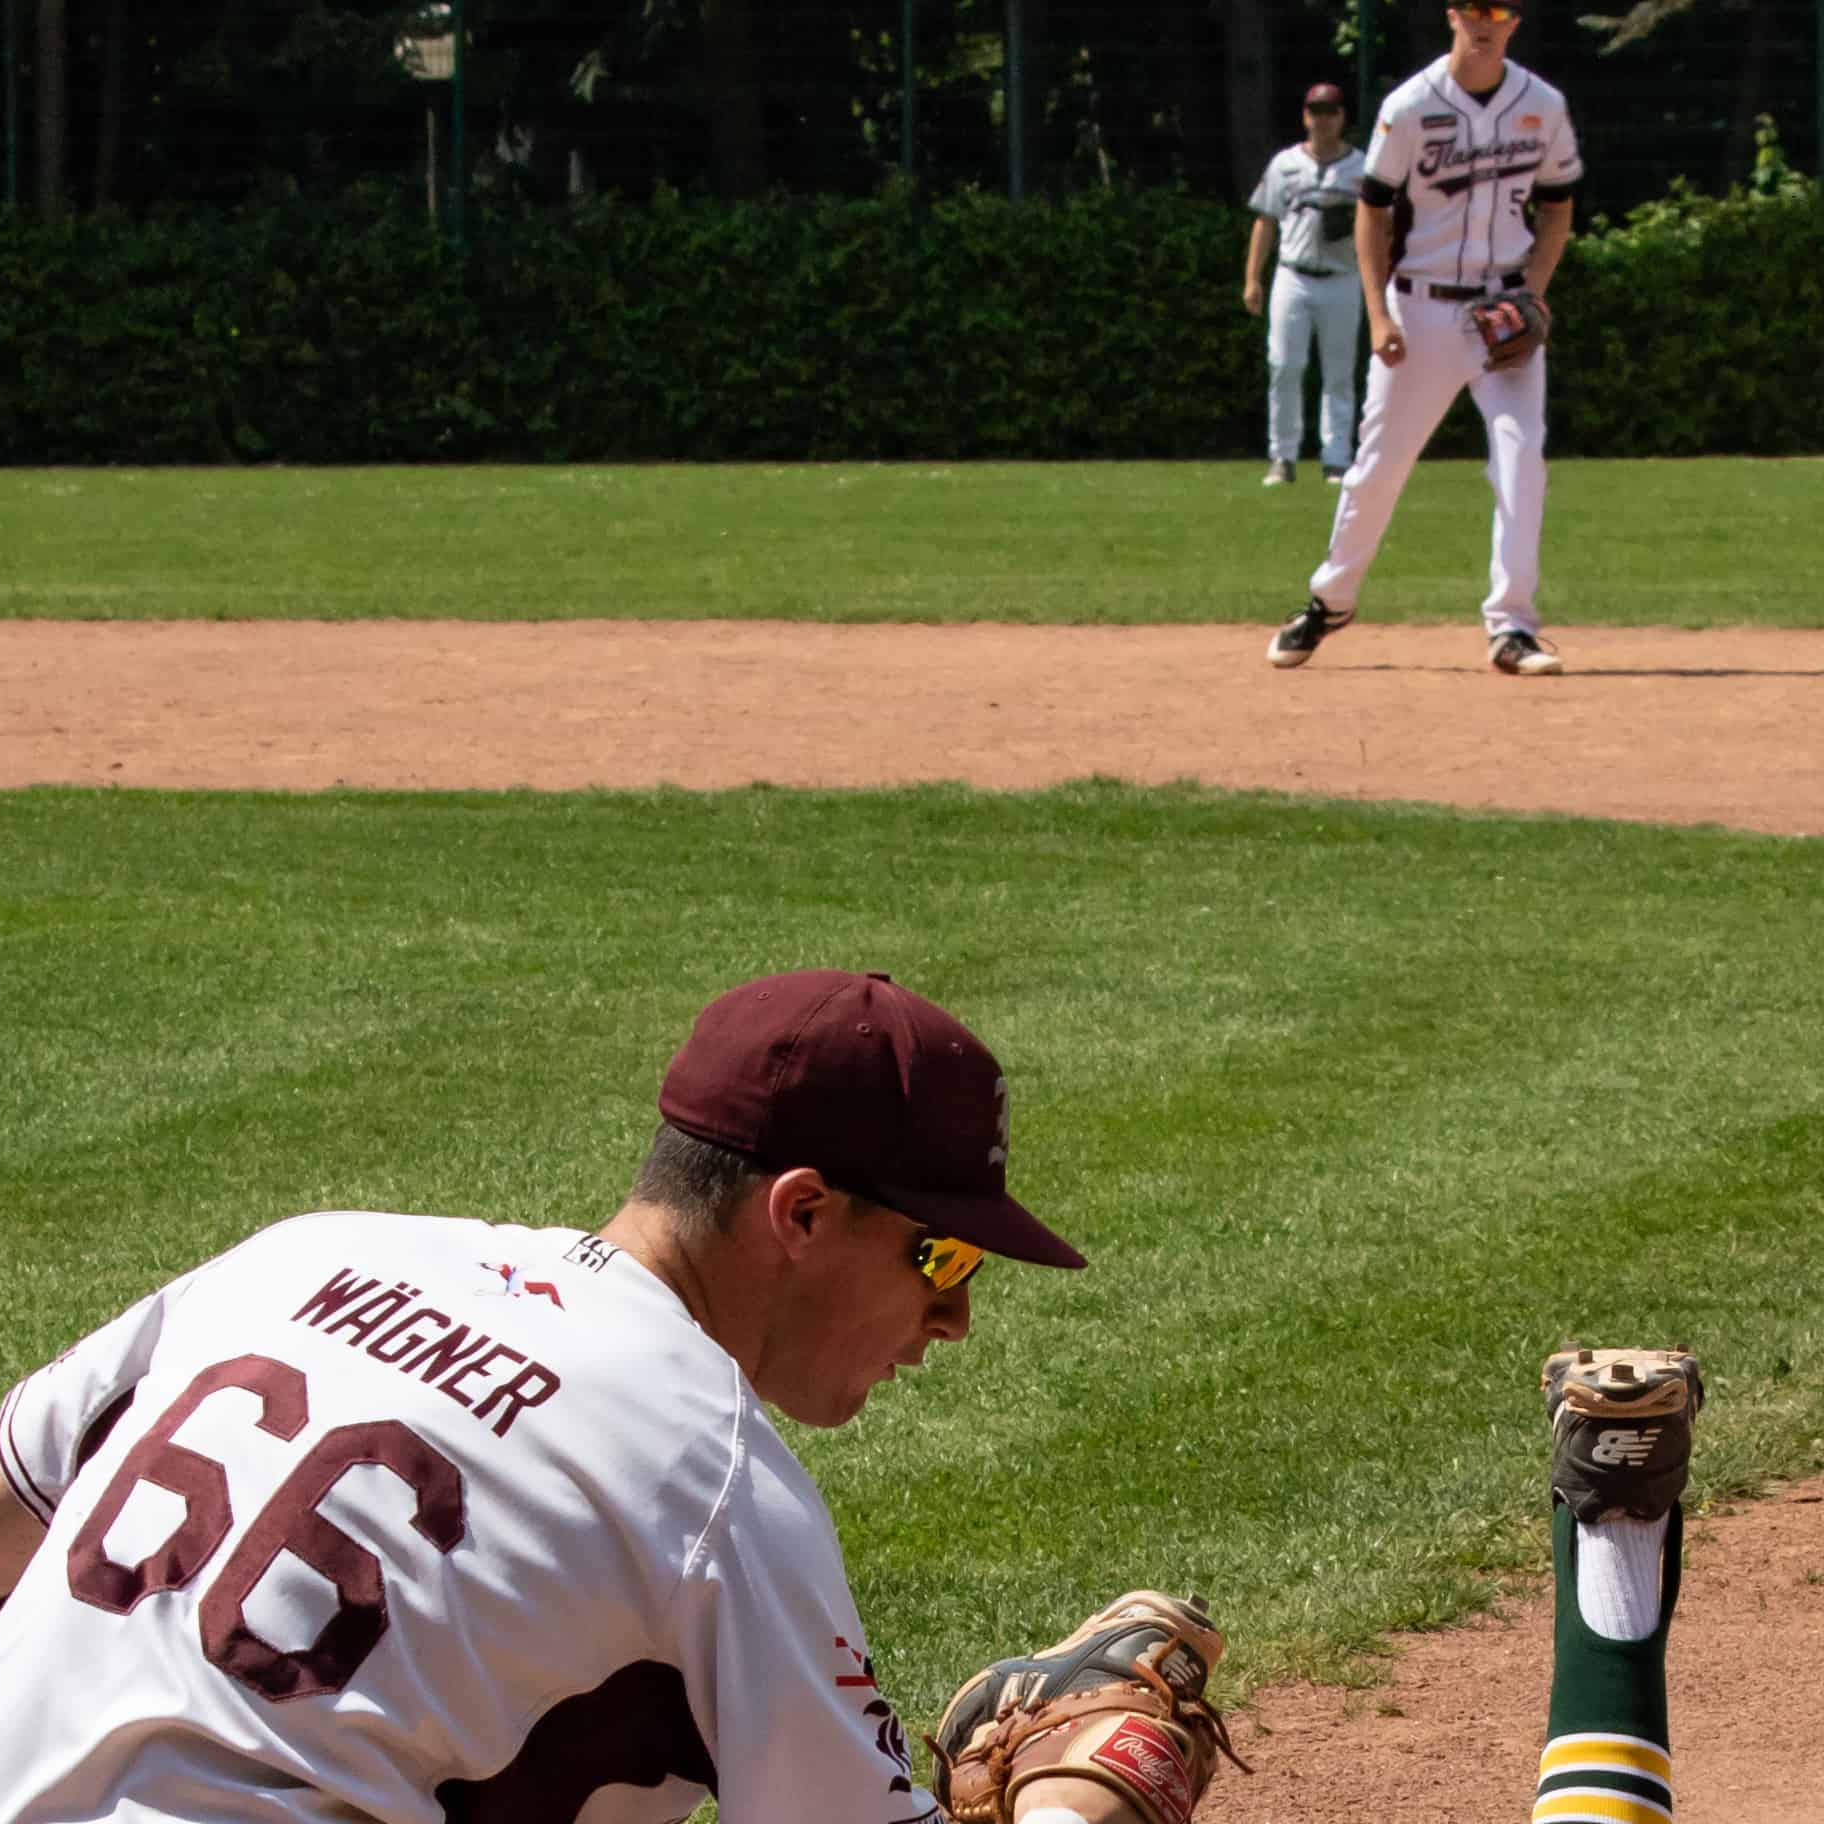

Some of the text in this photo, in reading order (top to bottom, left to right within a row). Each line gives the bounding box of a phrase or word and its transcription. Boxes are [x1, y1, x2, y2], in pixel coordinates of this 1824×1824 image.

[290, 1268, 561, 1438] WÄGNER
[67, 1353, 464, 1702] 66
[1113, 1736, 1182, 1792] Rawl
